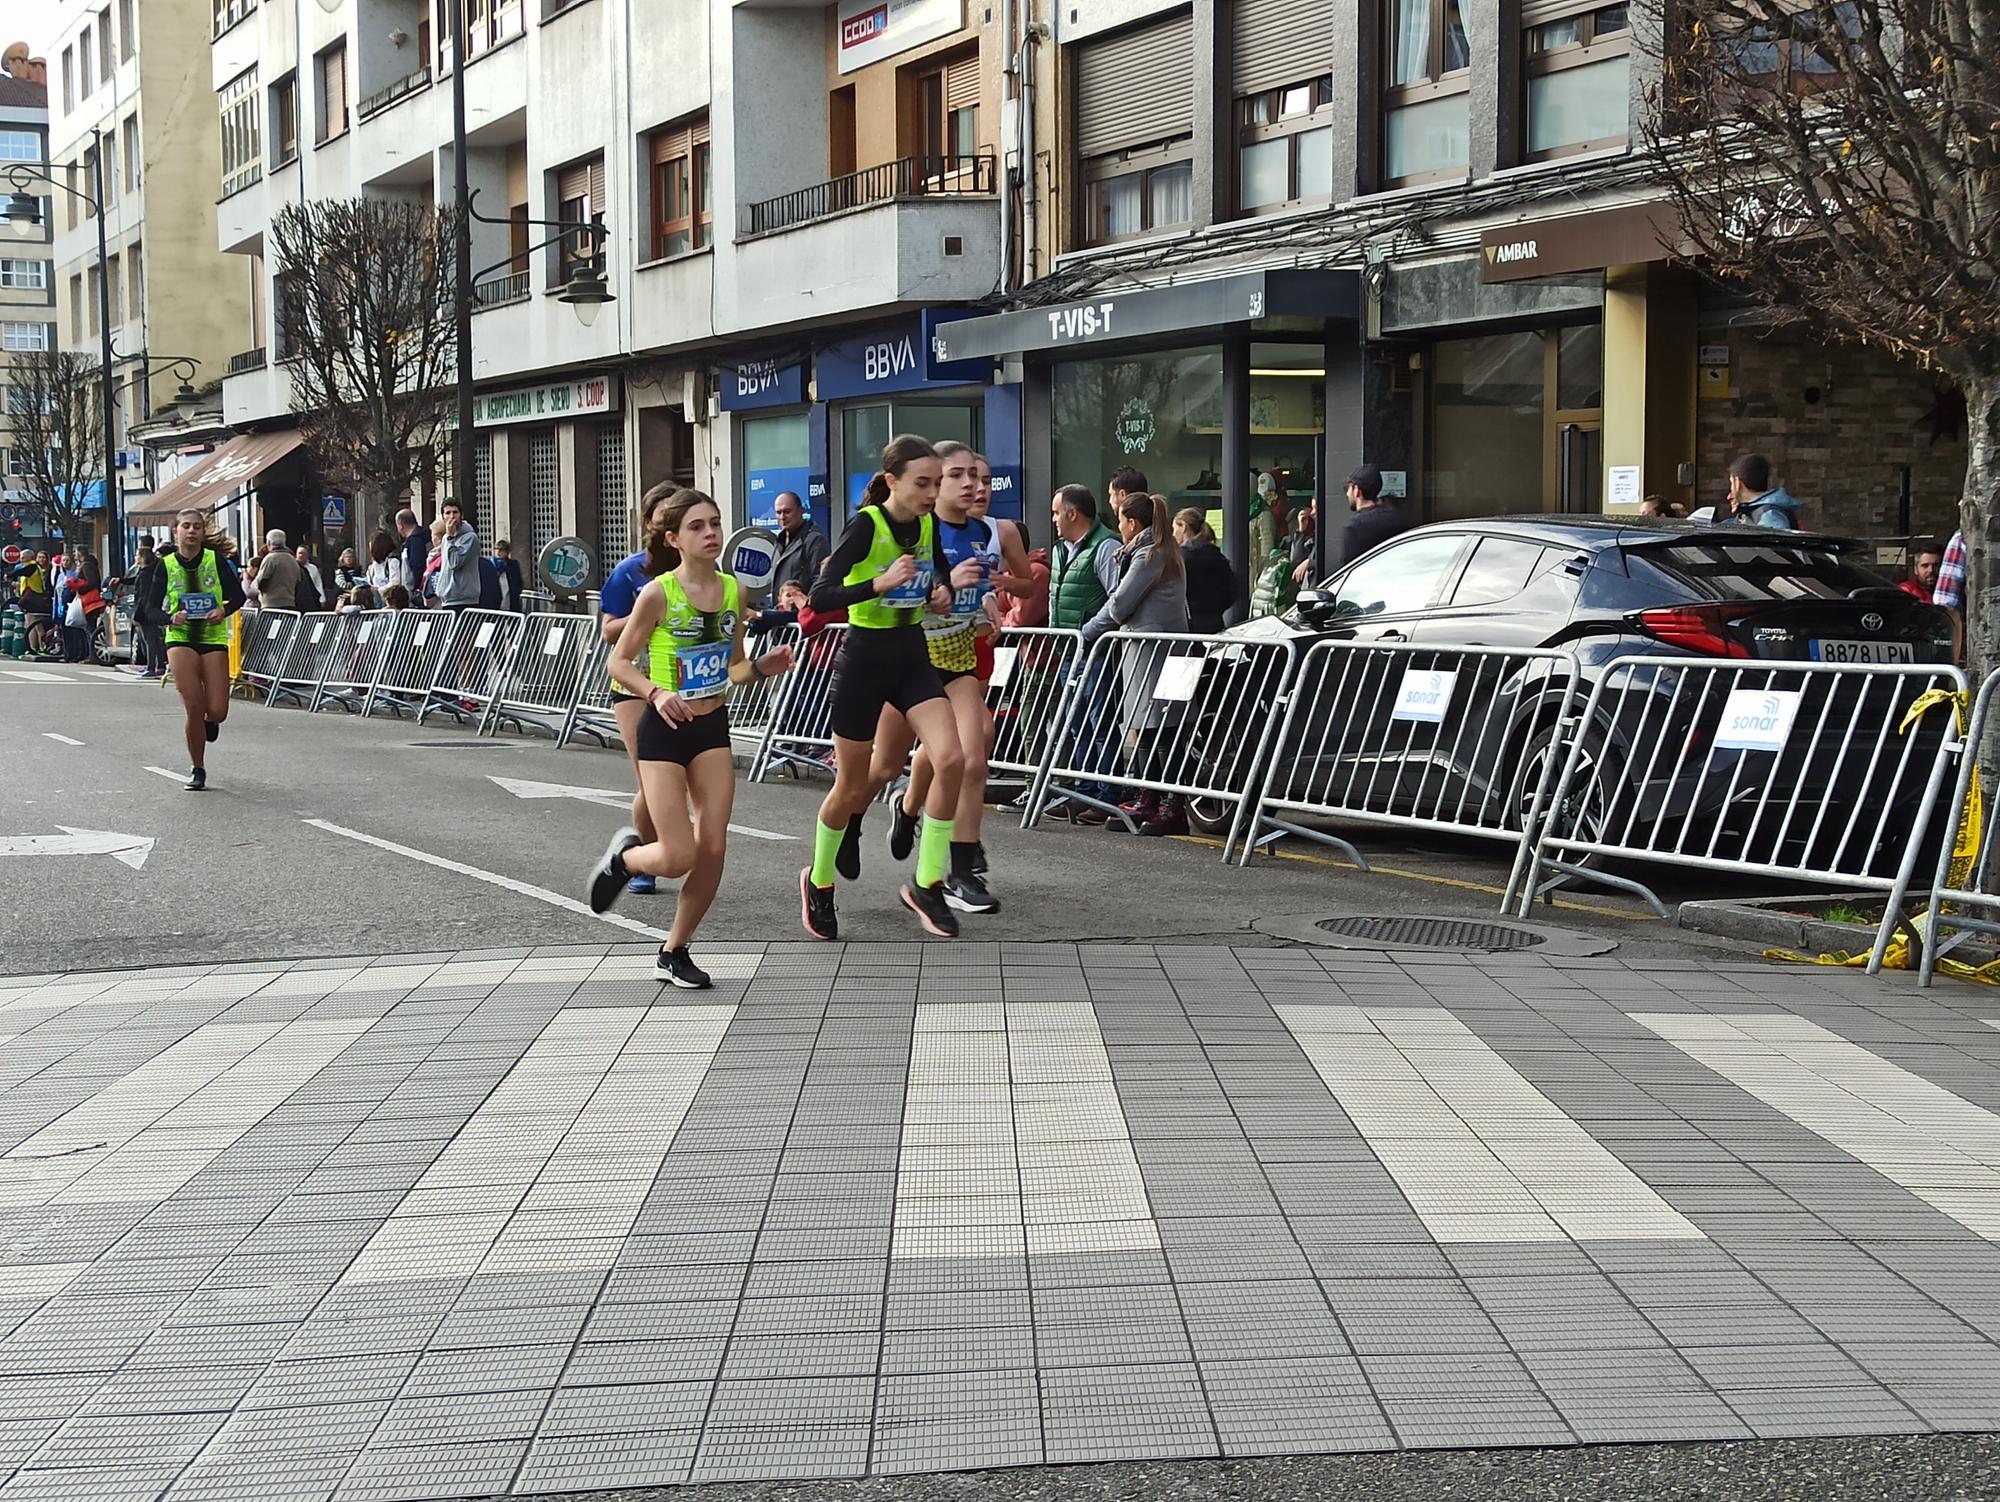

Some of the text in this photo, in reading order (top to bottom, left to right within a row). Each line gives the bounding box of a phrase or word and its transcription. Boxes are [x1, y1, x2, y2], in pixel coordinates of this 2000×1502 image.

[1496, 240, 1538, 264] AMBAR
[1048, 303, 1114, 340] T-VIS-T
[865, 335, 916, 381] BBVA
[738, 358, 779, 396] BBVA
[536, 389, 545, 414] DE
[551, 386, 571, 412] SIERO
[809, 482, 826, 497] BBVA
[991, 475, 1013, 491] BBVA
[183, 598, 213, 610] 1529
[1824, 643, 1871, 664] 8878
[1405, 690, 1441, 705] sonar
[1731, 715, 1780, 731] sonar
